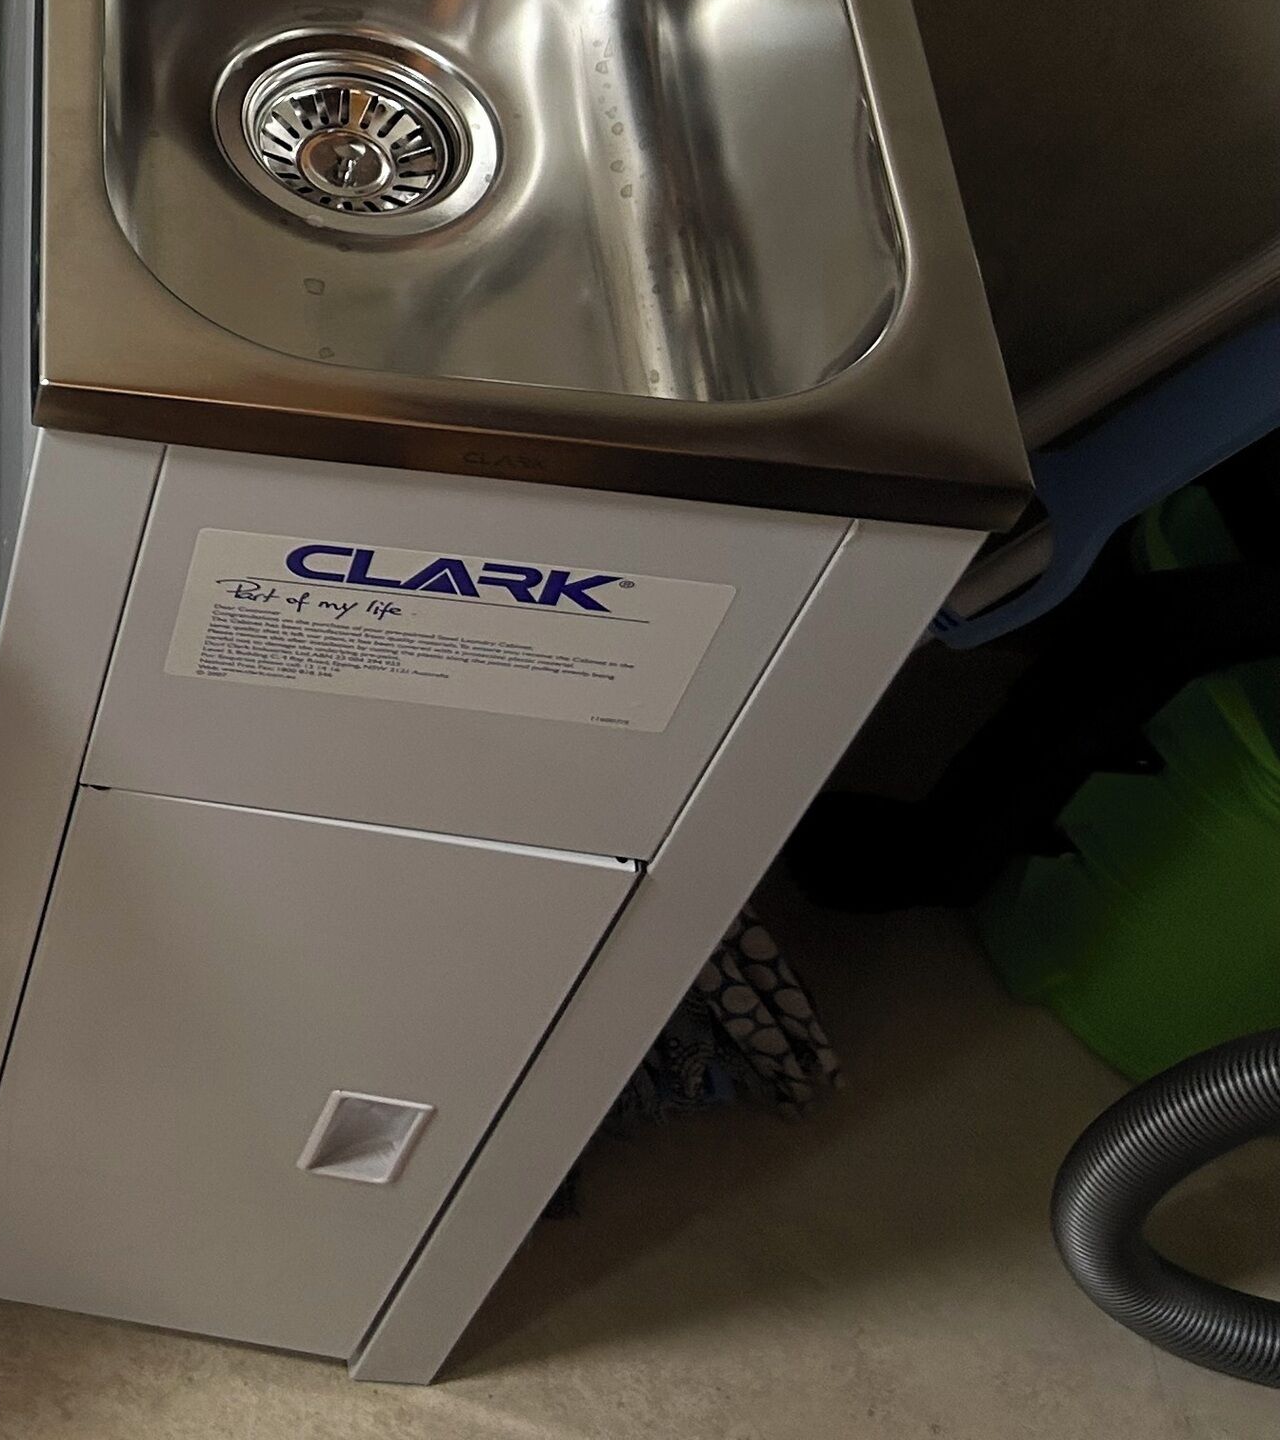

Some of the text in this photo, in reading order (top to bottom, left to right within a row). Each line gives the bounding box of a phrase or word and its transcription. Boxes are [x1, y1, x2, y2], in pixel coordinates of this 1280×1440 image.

[215, 577, 402, 620] Part of my life
[285, 544, 623, 613] CLARK
